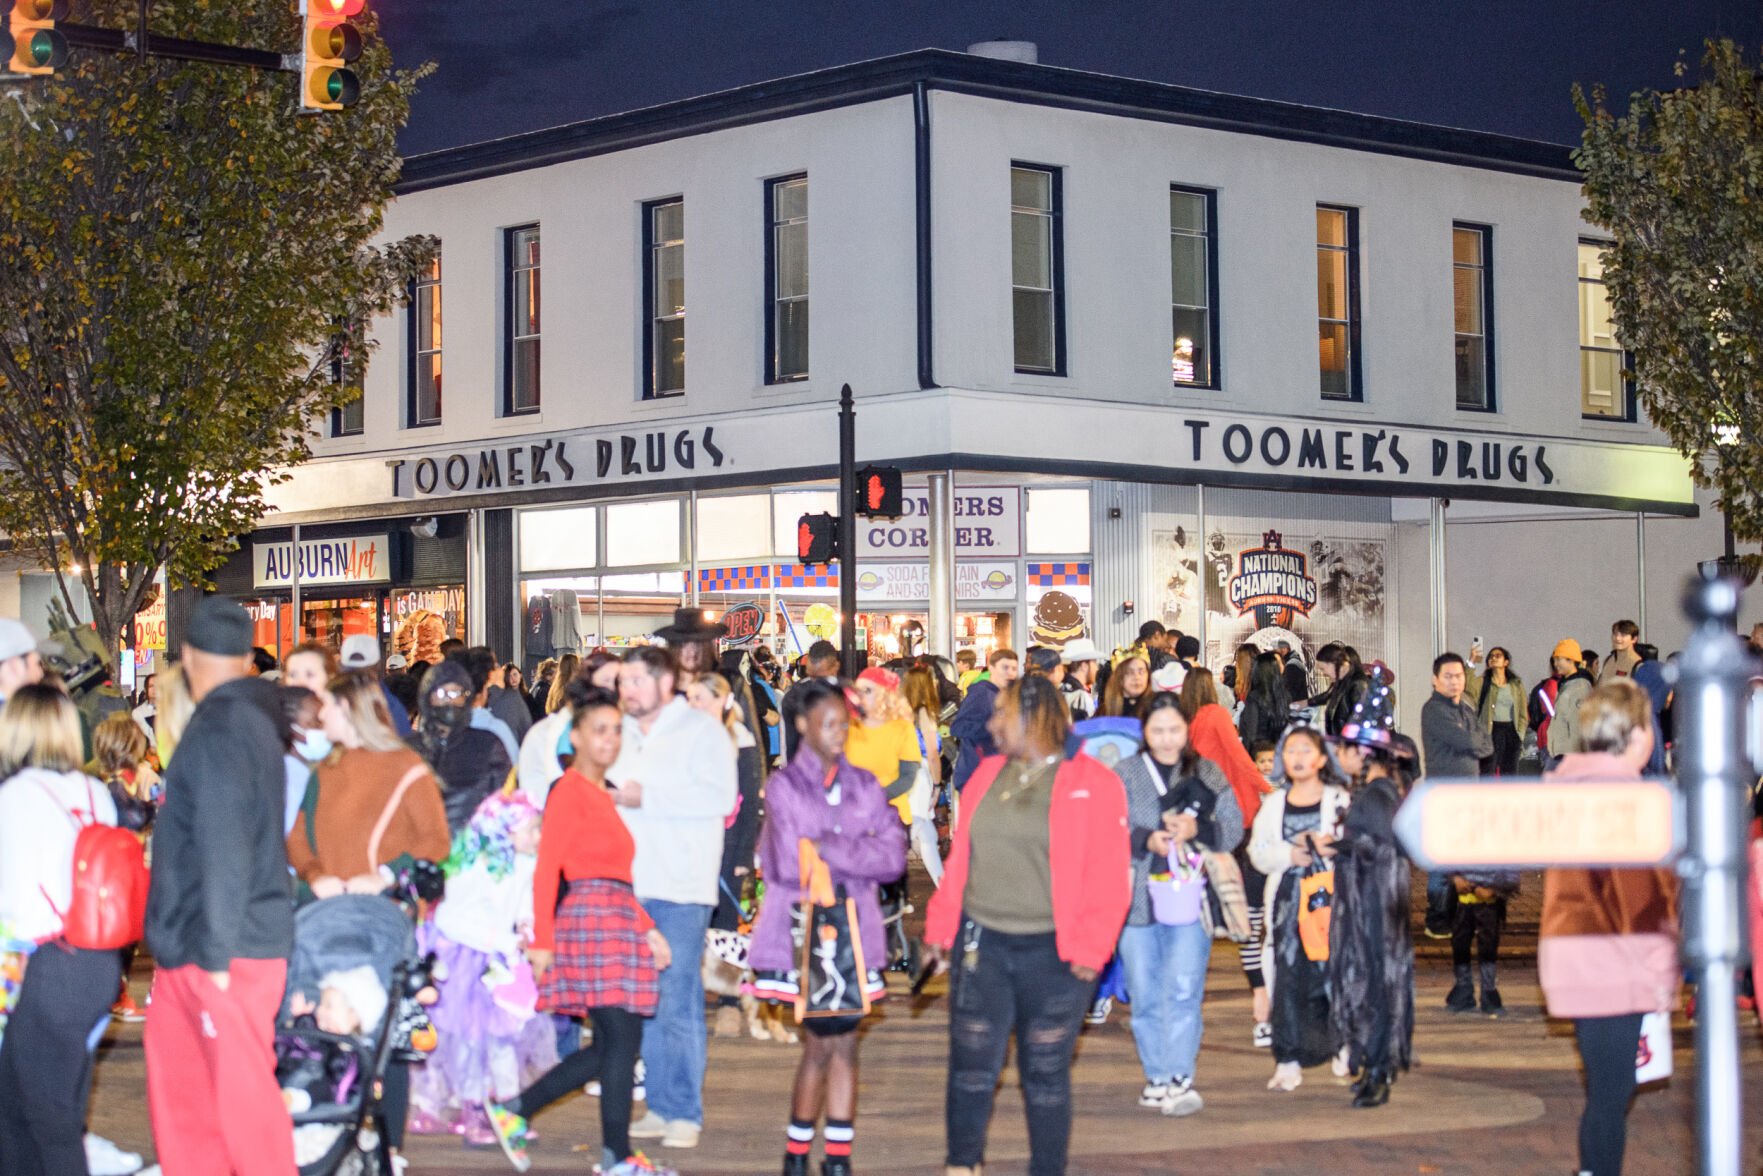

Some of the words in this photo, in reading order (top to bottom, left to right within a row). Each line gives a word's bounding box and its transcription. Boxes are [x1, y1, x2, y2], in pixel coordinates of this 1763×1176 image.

[385, 438, 574, 497] TOOMER'S
[596, 426, 724, 478] DRUGS
[1184, 419, 1410, 474] TOOMER'S
[1432, 439, 1554, 485] DRUGS
[868, 527, 994, 548] CORER
[887, 565, 917, 581] SODA
[922, 565, 979, 581] FAIN
[1243, 553, 1302, 576] NATIONAL
[886, 583, 911, 598] AND
[1231, 571, 1316, 604] CHAMPIONS
[260, 601, 277, 621] Day
[396, 596, 406, 615] is
[408, 588, 463, 613] GAMEDAY
[1266, 605, 1282, 613] 2010
[723, 608, 758, 639] OPEN
